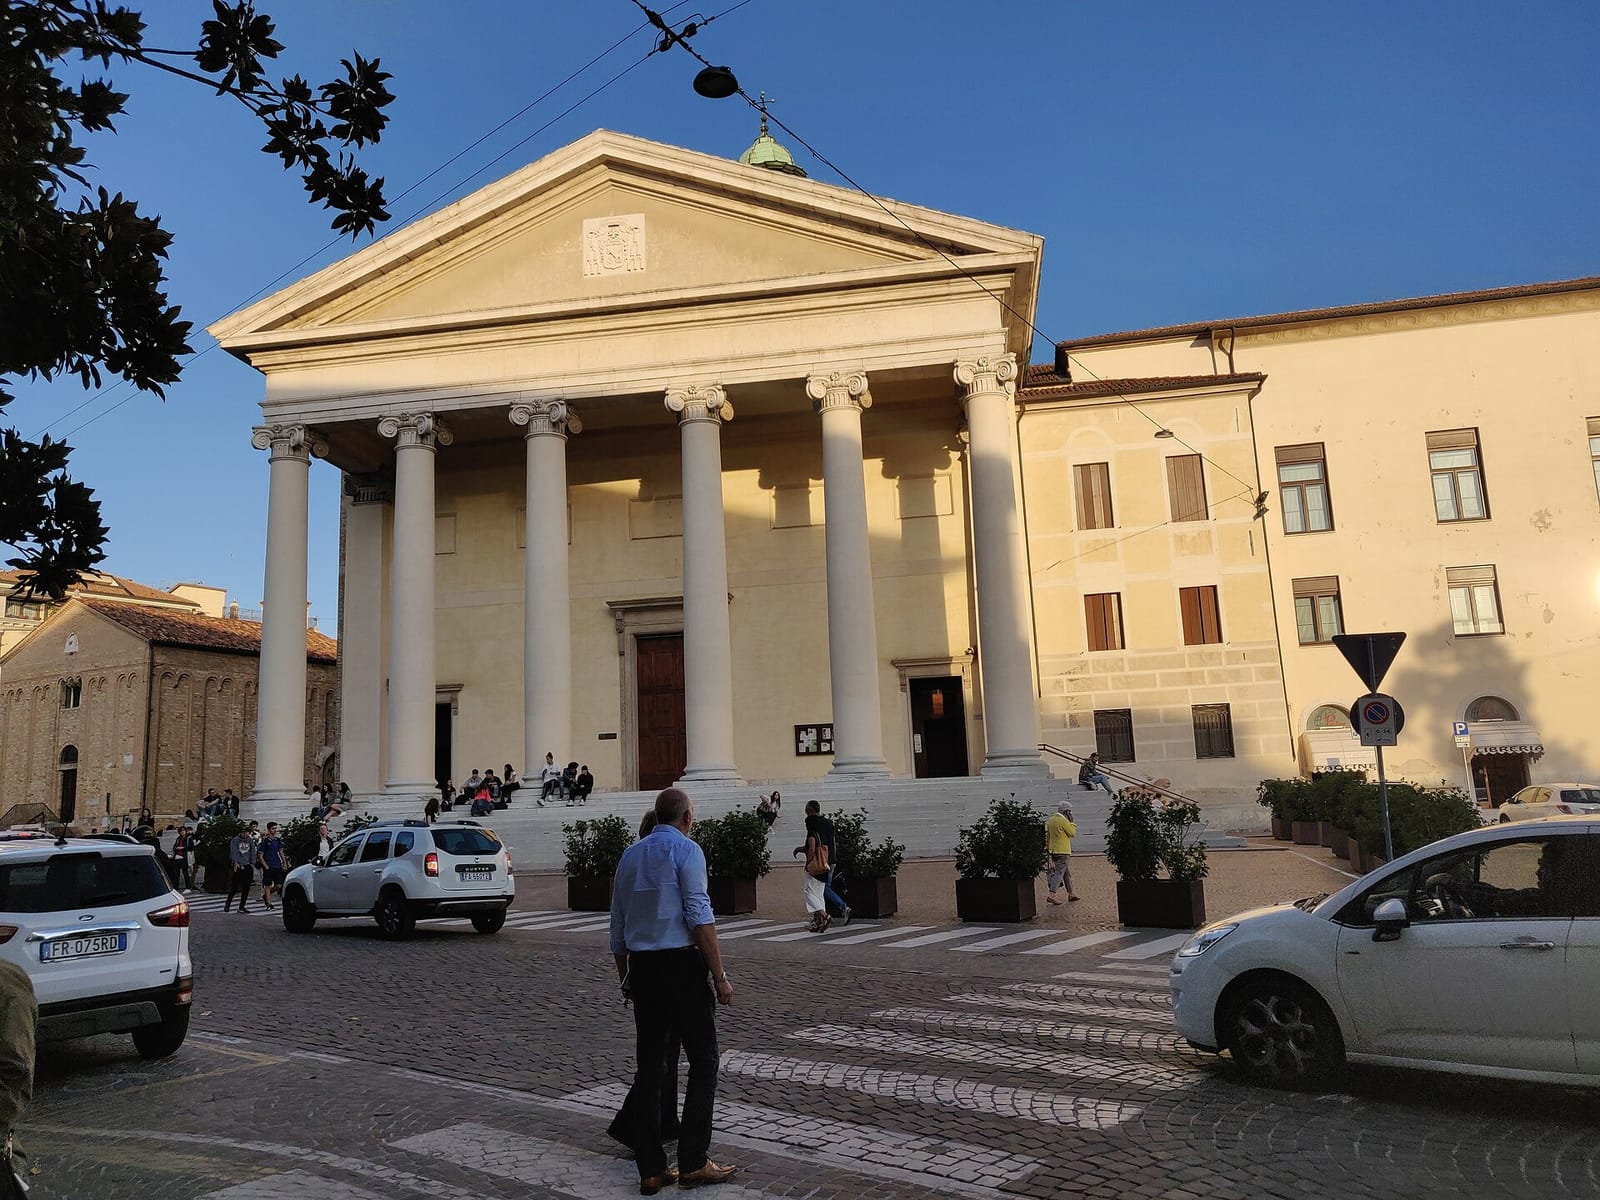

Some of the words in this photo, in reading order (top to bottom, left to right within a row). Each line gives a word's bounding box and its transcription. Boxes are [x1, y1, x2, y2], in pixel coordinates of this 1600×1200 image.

[1455, 723, 1466, 735] P
[1476, 745, 1544, 753] LIBRERIA
[1316, 763, 1376, 772] PAOLINE
